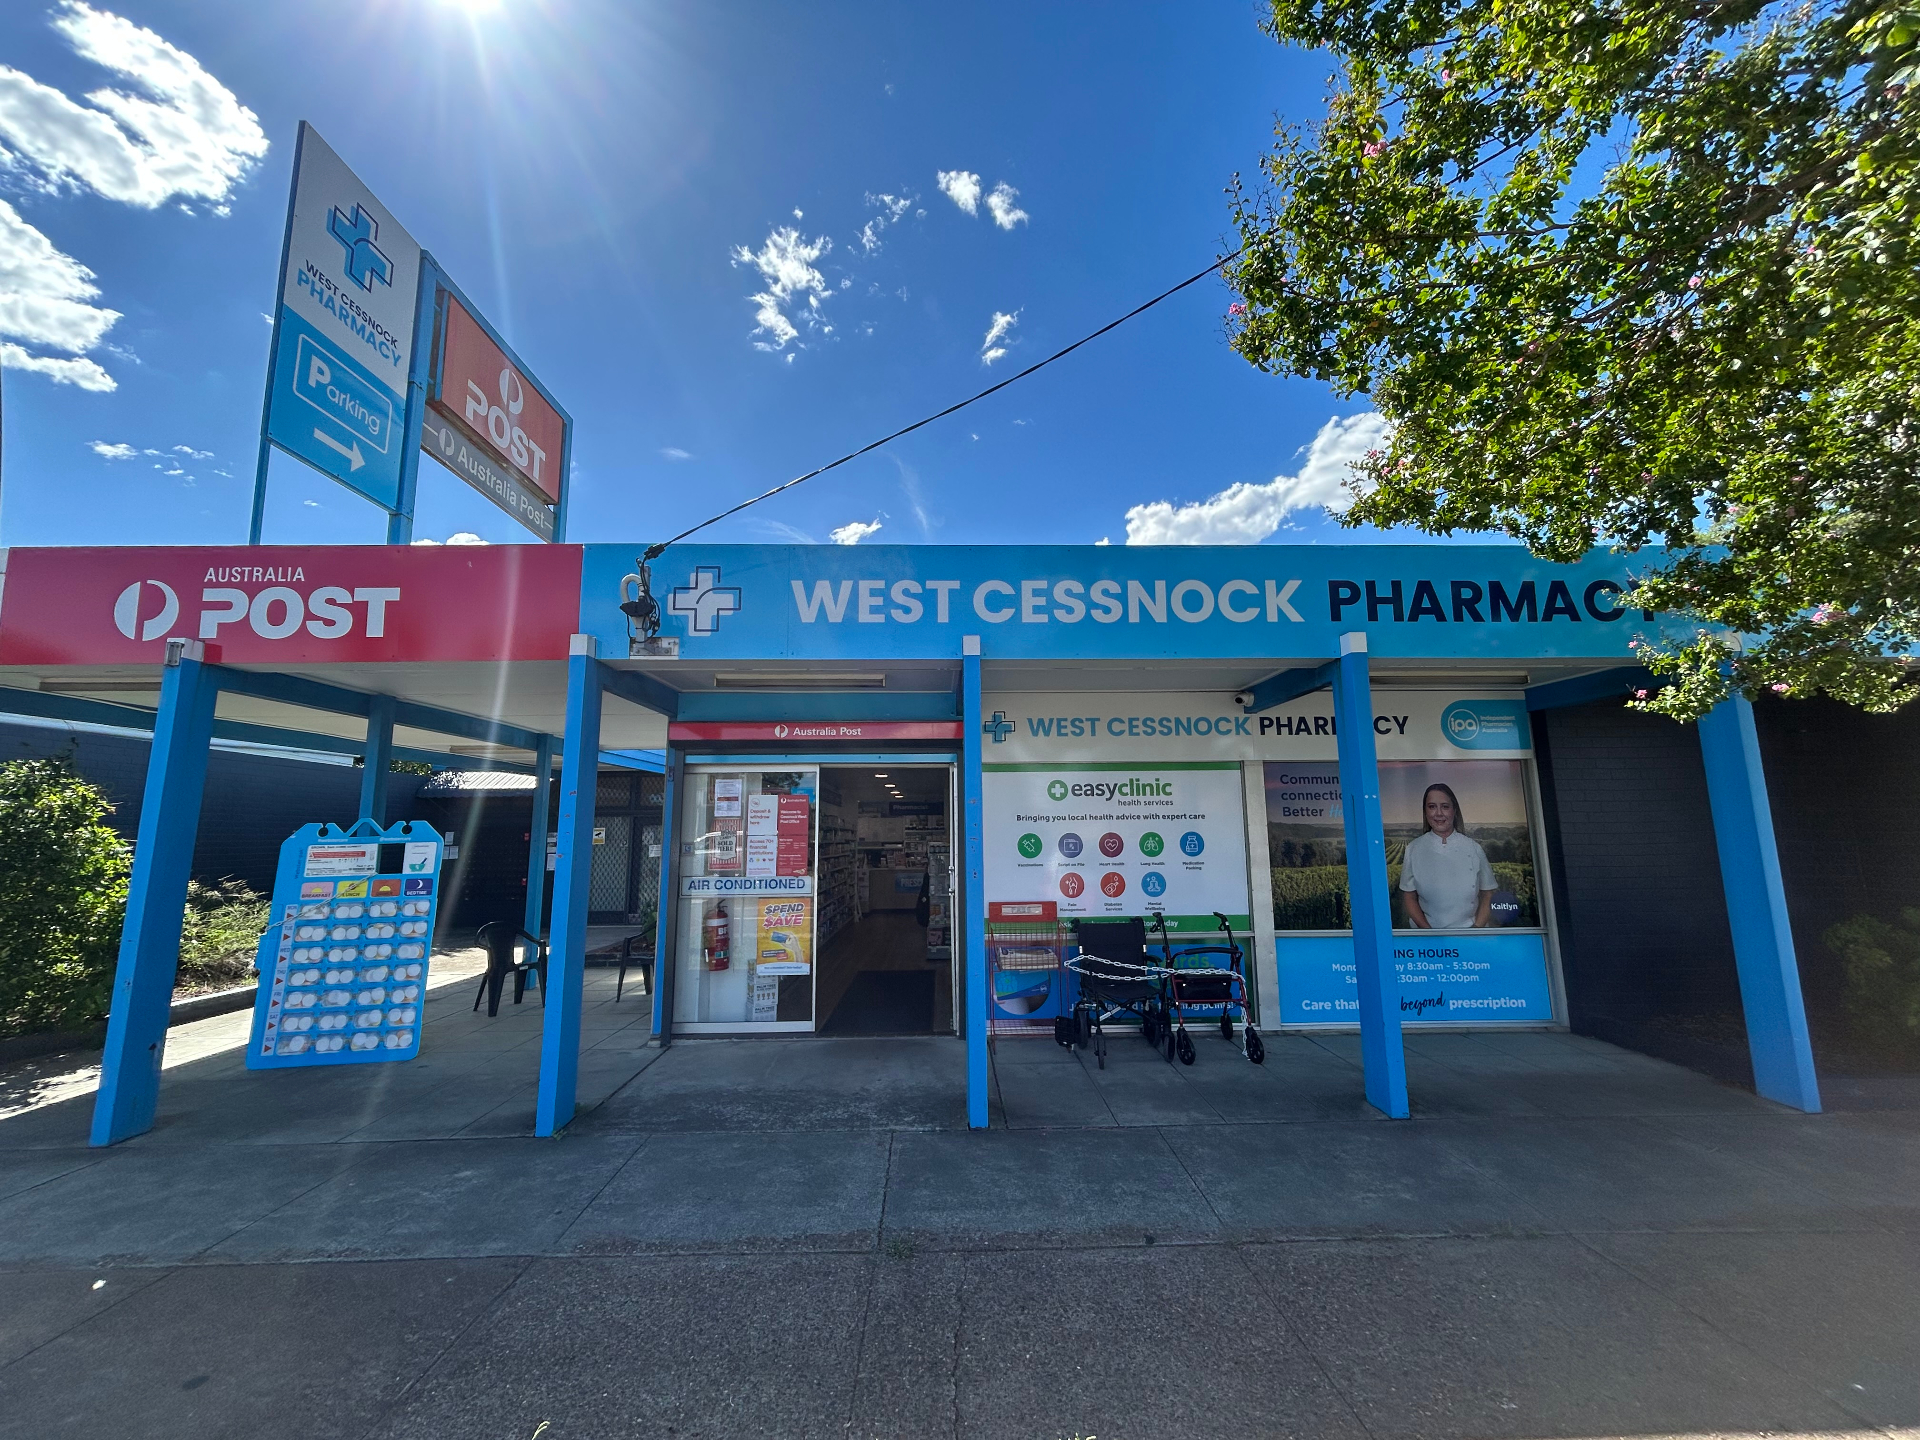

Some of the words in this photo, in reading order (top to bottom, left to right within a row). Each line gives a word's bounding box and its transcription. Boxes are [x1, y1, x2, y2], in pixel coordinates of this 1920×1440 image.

[305, 258, 339, 298] WEST
[340, 293, 398, 349] CESSNOCK
[297, 268, 401, 369] PHARMACY
[308, 354, 381, 436] Parking
[466, 378, 546, 481] POST
[457, 448, 517, 507] Australia
[520, 494, 546, 529] Post
[204, 566, 305, 583] AUSTRALIA
[791, 580, 960, 624] WEST
[973, 578, 1304, 624] CESSNOCK
[200, 587, 400, 640] POST
[793, 727, 836, 736] Australia
[840, 727, 862, 736] Post
[1026, 717, 1100, 737] WEST
[1106, 716, 1252, 736] CESSNOCK
[1260, 716, 1409, 736] PHARCY
[1451, 718, 1476, 732] ipa
[1280, 774, 1340, 784] Commun
[1070, 778, 1172, 801] easyclinic
[1016, 814, 1050, 823] Bringing
[1162, 813, 1187, 822] expert
[1282, 806, 1324, 817] Better
[688, 880, 710, 890] AIR
[714, 878, 806, 890] CONDITIONED
[1418, 949, 1459, 958] HOURS
[1407, 962, 1443, 971] 8:30am
[1453, 962, 1490, 971] 5:30pm
[1397, 975, 1428, 983] :30am
[1437, 974, 1479, 983] 12:00pm
[1302, 1000, 1331, 1010] Care
[1401, 990, 1446, 1016] beyond
[1450, 997, 1526, 1010] prescription
